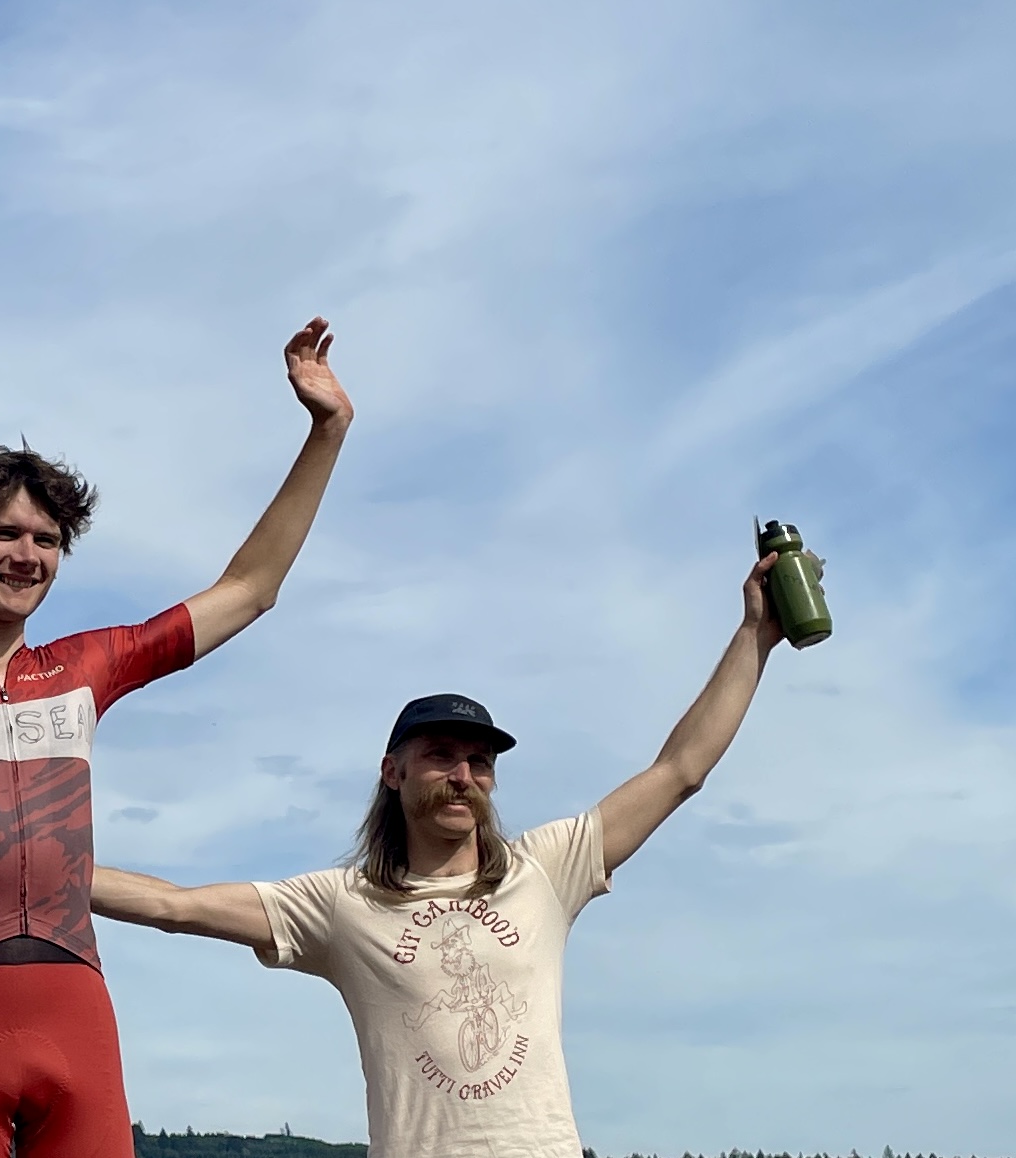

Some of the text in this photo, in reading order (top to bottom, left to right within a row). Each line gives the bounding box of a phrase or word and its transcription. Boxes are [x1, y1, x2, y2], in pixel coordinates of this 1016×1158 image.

[17, 664, 64, 682] PACTIMO
[393, 928, 421, 965] GIT
[415, 1034, 529, 1101] TUTTI GRAVEL INN
